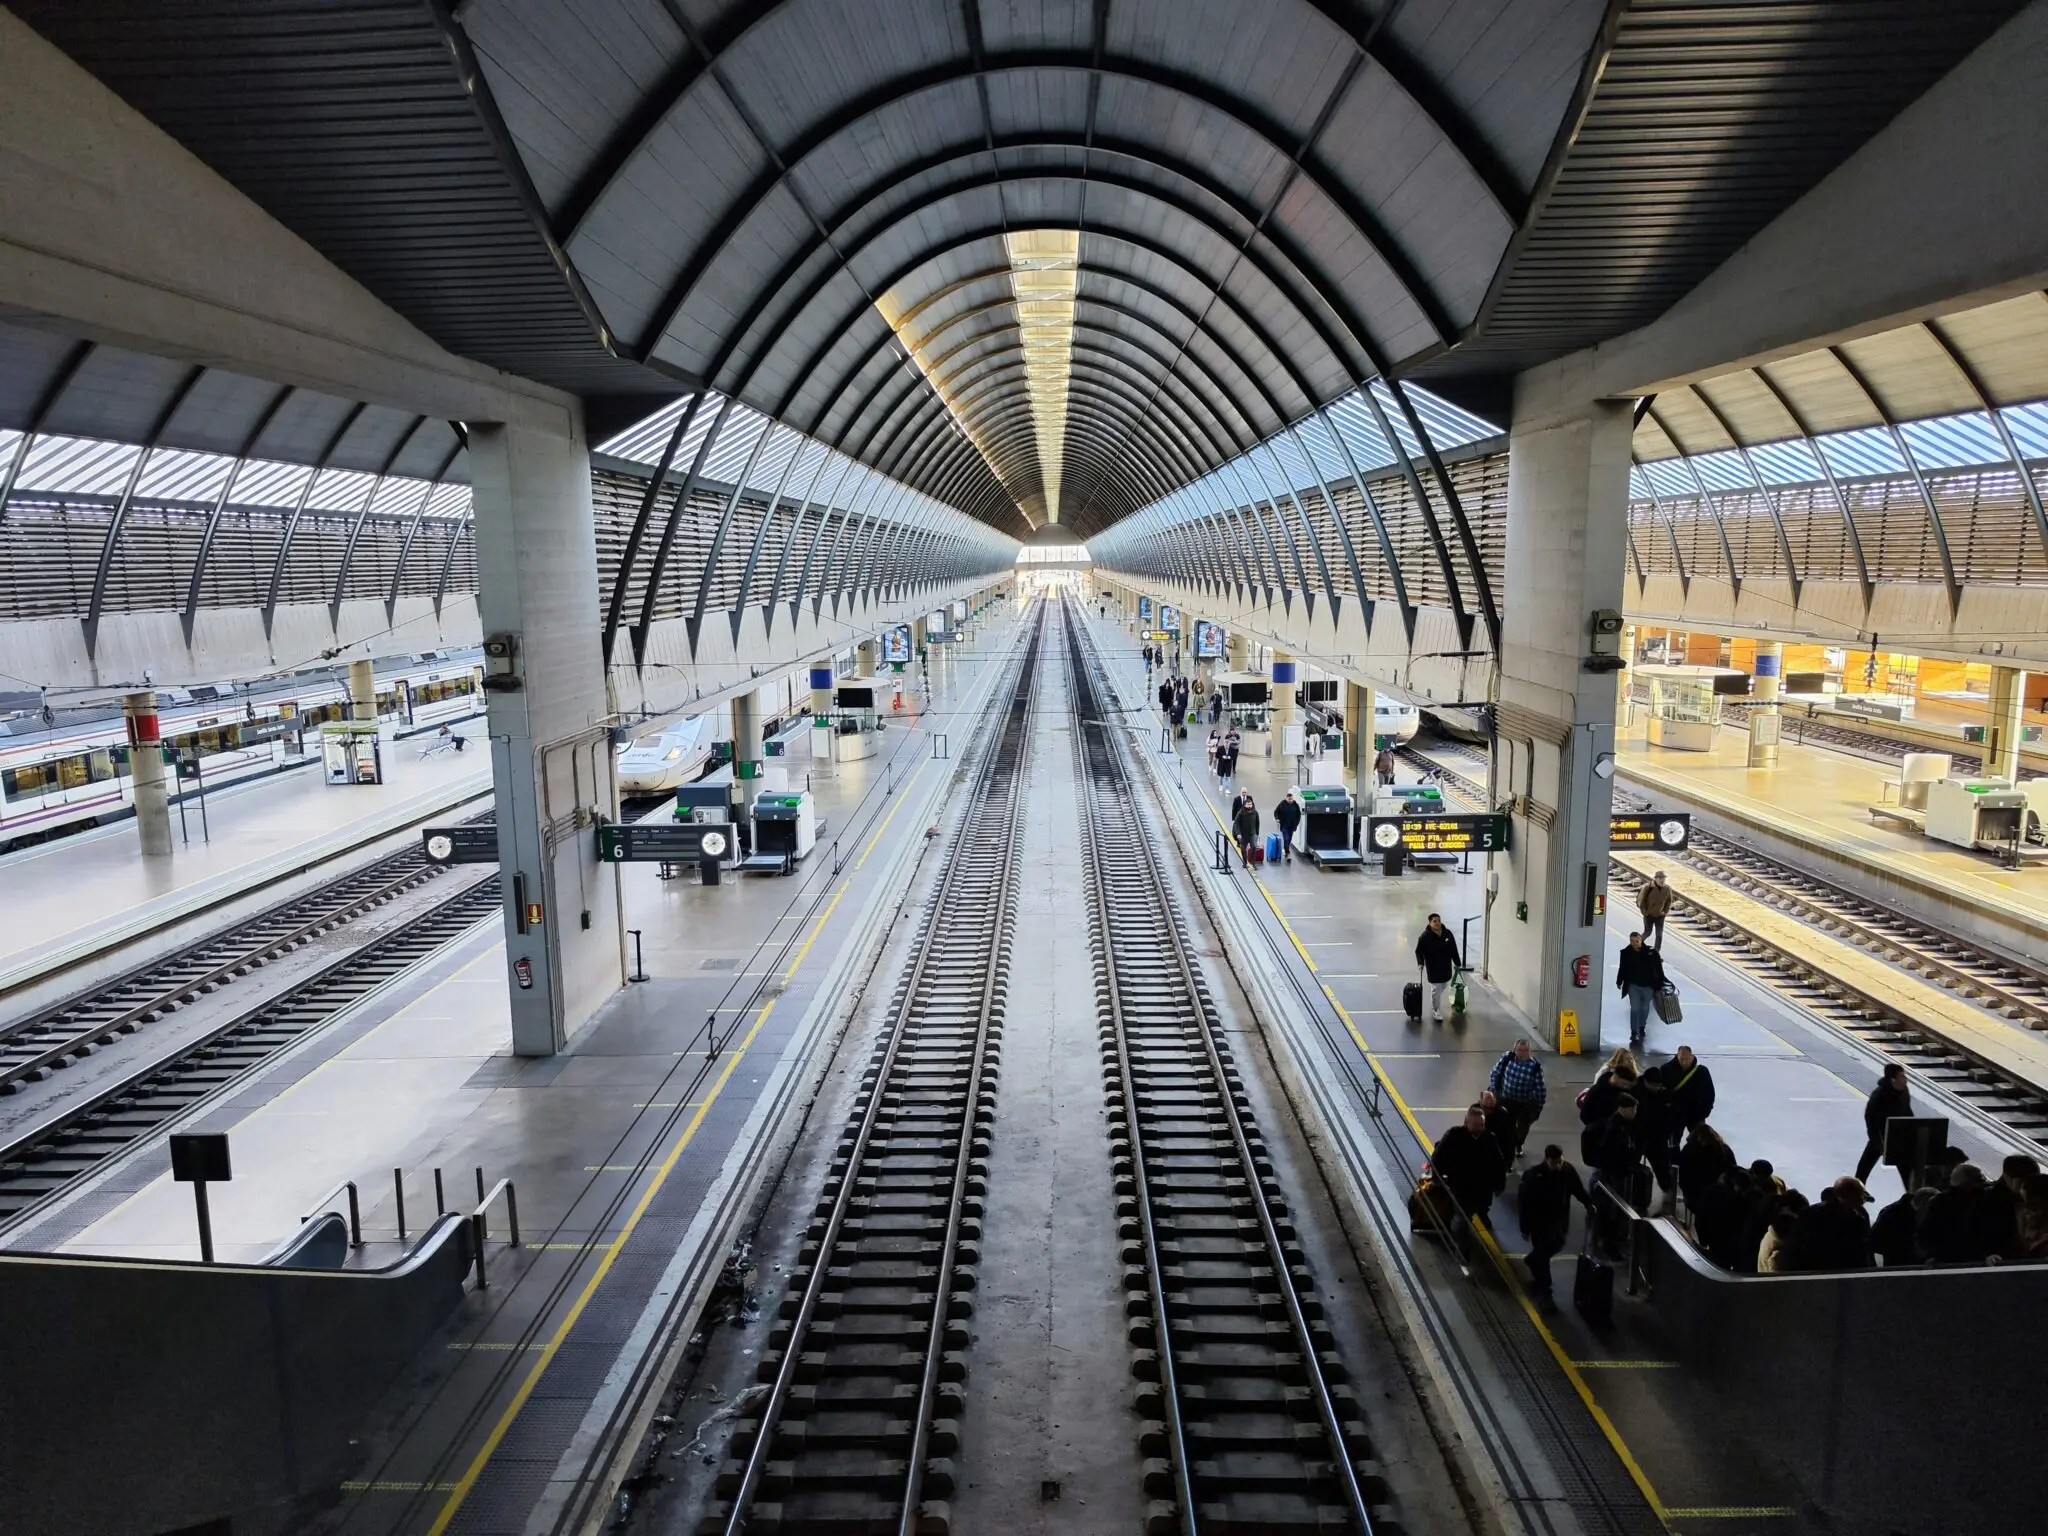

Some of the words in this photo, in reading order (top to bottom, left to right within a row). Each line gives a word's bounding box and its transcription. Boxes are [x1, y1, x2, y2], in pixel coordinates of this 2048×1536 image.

[778, 748, 784, 756] 6
[754, 762, 764, 776] A
[1446, 833, 1471, 841] ATOCHA
[1483, 833, 1493, 848] 5
[1634, 832, 1655, 840] JUSTA
[613, 844, 624, 858] 6
